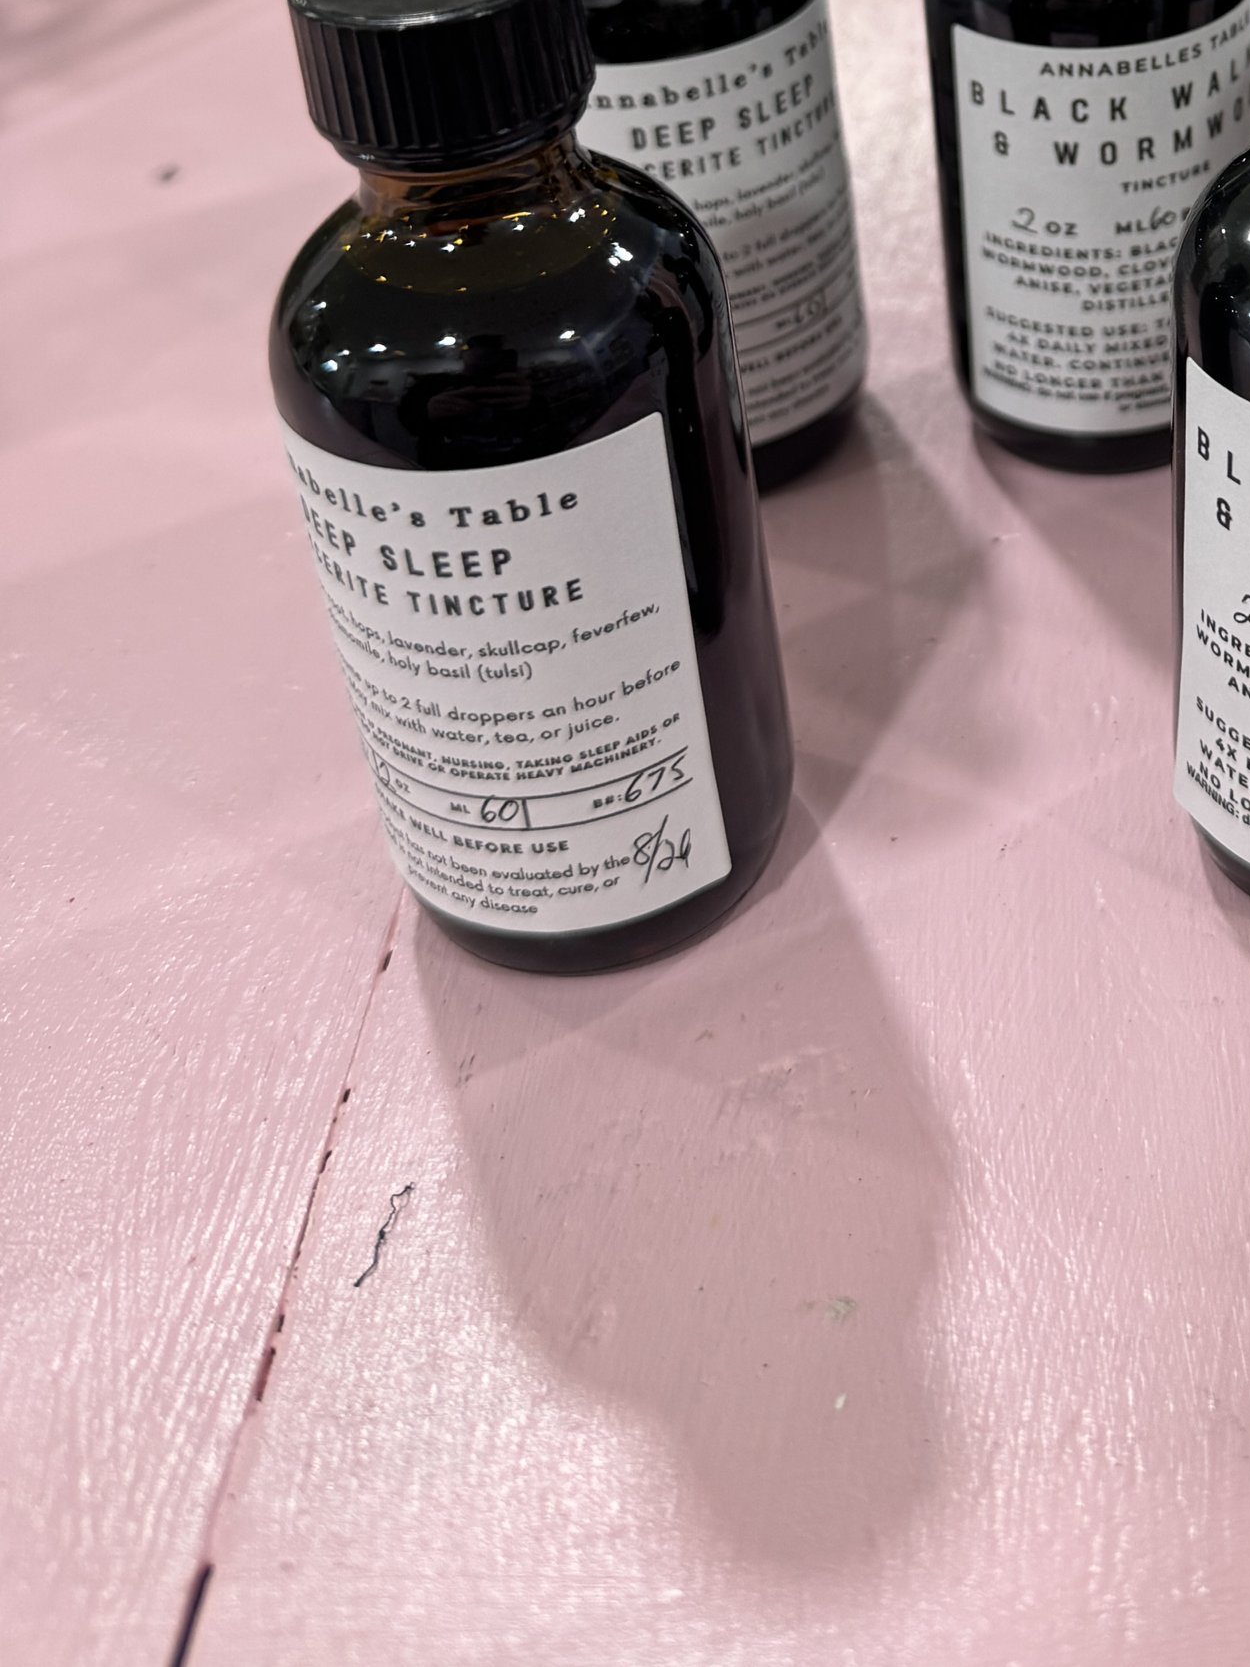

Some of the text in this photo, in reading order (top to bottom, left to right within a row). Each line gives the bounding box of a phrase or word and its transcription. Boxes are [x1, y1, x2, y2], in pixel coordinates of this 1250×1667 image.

[1039, 42, 1202, 79] ANNABELLES
[593, 61, 773, 111] nnabelle's
[968, 78, 1128, 124] BLACK
[628, 72, 814, 152] DEEP SLEEP
[1119, 159, 1212, 195] TINCTURE
[1010, 206, 1039, 235] 2
[1044, 220, 1079, 237] OZ
[448, 490, 579, 529] Table
[379, 542, 513, 579] SLEEP
[405, 576, 584, 618] TINCTURE
[387, 602, 661, 661] lavender, skullcap, feverfew,
[426, 660, 534, 683] basil (tulsi)
[447, 659, 682, 728] droppers an hour before
[431, 713, 621, 746] water, tea, juice.
[515, 726, 659, 771] TAKING SLEEP AIDS
[516, 737, 663, 781] HEAVY MACHINERY.
[1198, 760, 1222, 790] NO
[408, 814, 570, 855] WELL BEFORE USE
[450, 855, 575, 882] been evaluated
[479, 897, 539, 915] disease
[507, 881, 600, 899] treat, cure,
